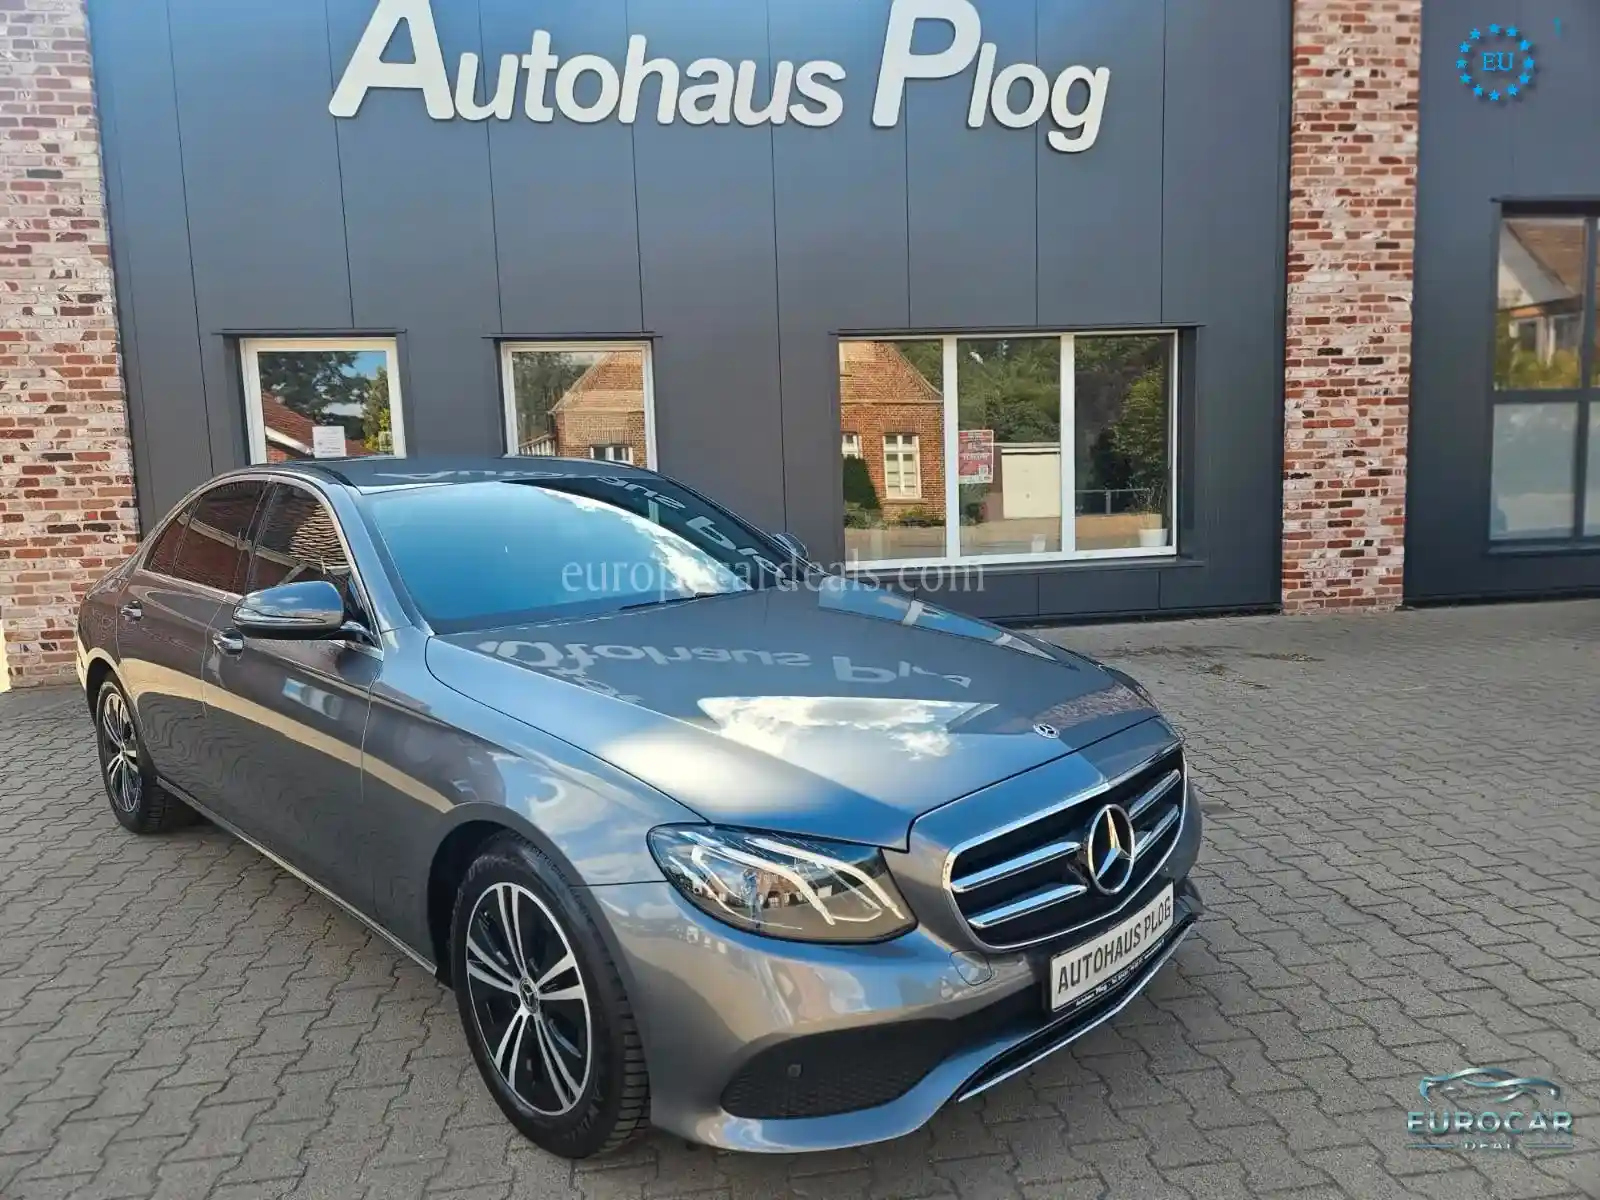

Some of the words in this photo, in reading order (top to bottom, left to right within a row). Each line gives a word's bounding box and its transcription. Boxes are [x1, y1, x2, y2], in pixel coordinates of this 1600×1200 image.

[329, 0, 845, 127] Autohaus
[873, 0, 1111, 153] Plog
[1057, 922, 1142, 995] AUTOHAUS
[1143, 896, 1172, 940] PLOG
